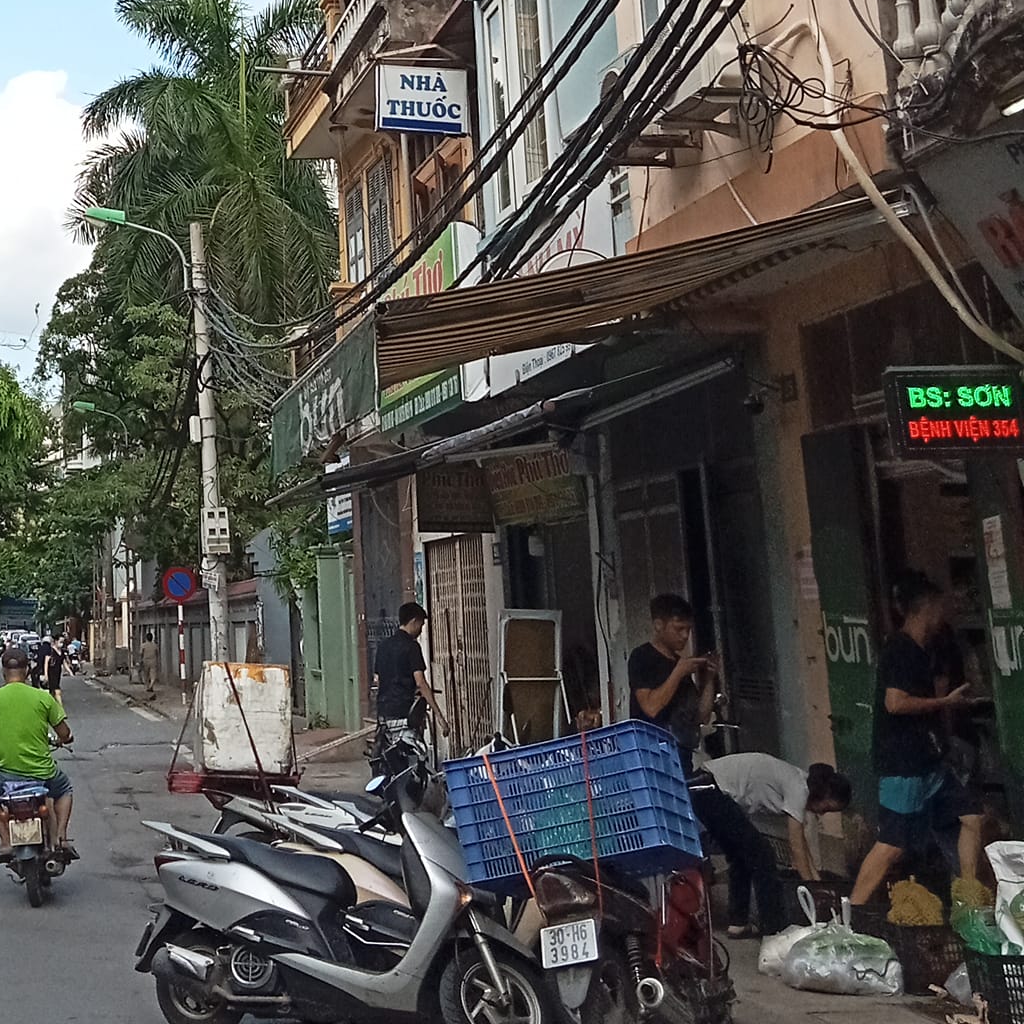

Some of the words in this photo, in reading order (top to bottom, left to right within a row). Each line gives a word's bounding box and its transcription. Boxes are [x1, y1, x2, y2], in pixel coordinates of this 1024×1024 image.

[399, 71, 447, 92] NHÀ
[386, 95, 461, 119] THUỐC
[907, 385, 951, 408] BS:
[957, 384, 1012, 407] SƠN
[908, 416, 952, 443] BỆNH
[954, 415, 990, 443] VIỆN
[991, 418, 1019, 438] 354
[550, 942, 589, 964] 3984
